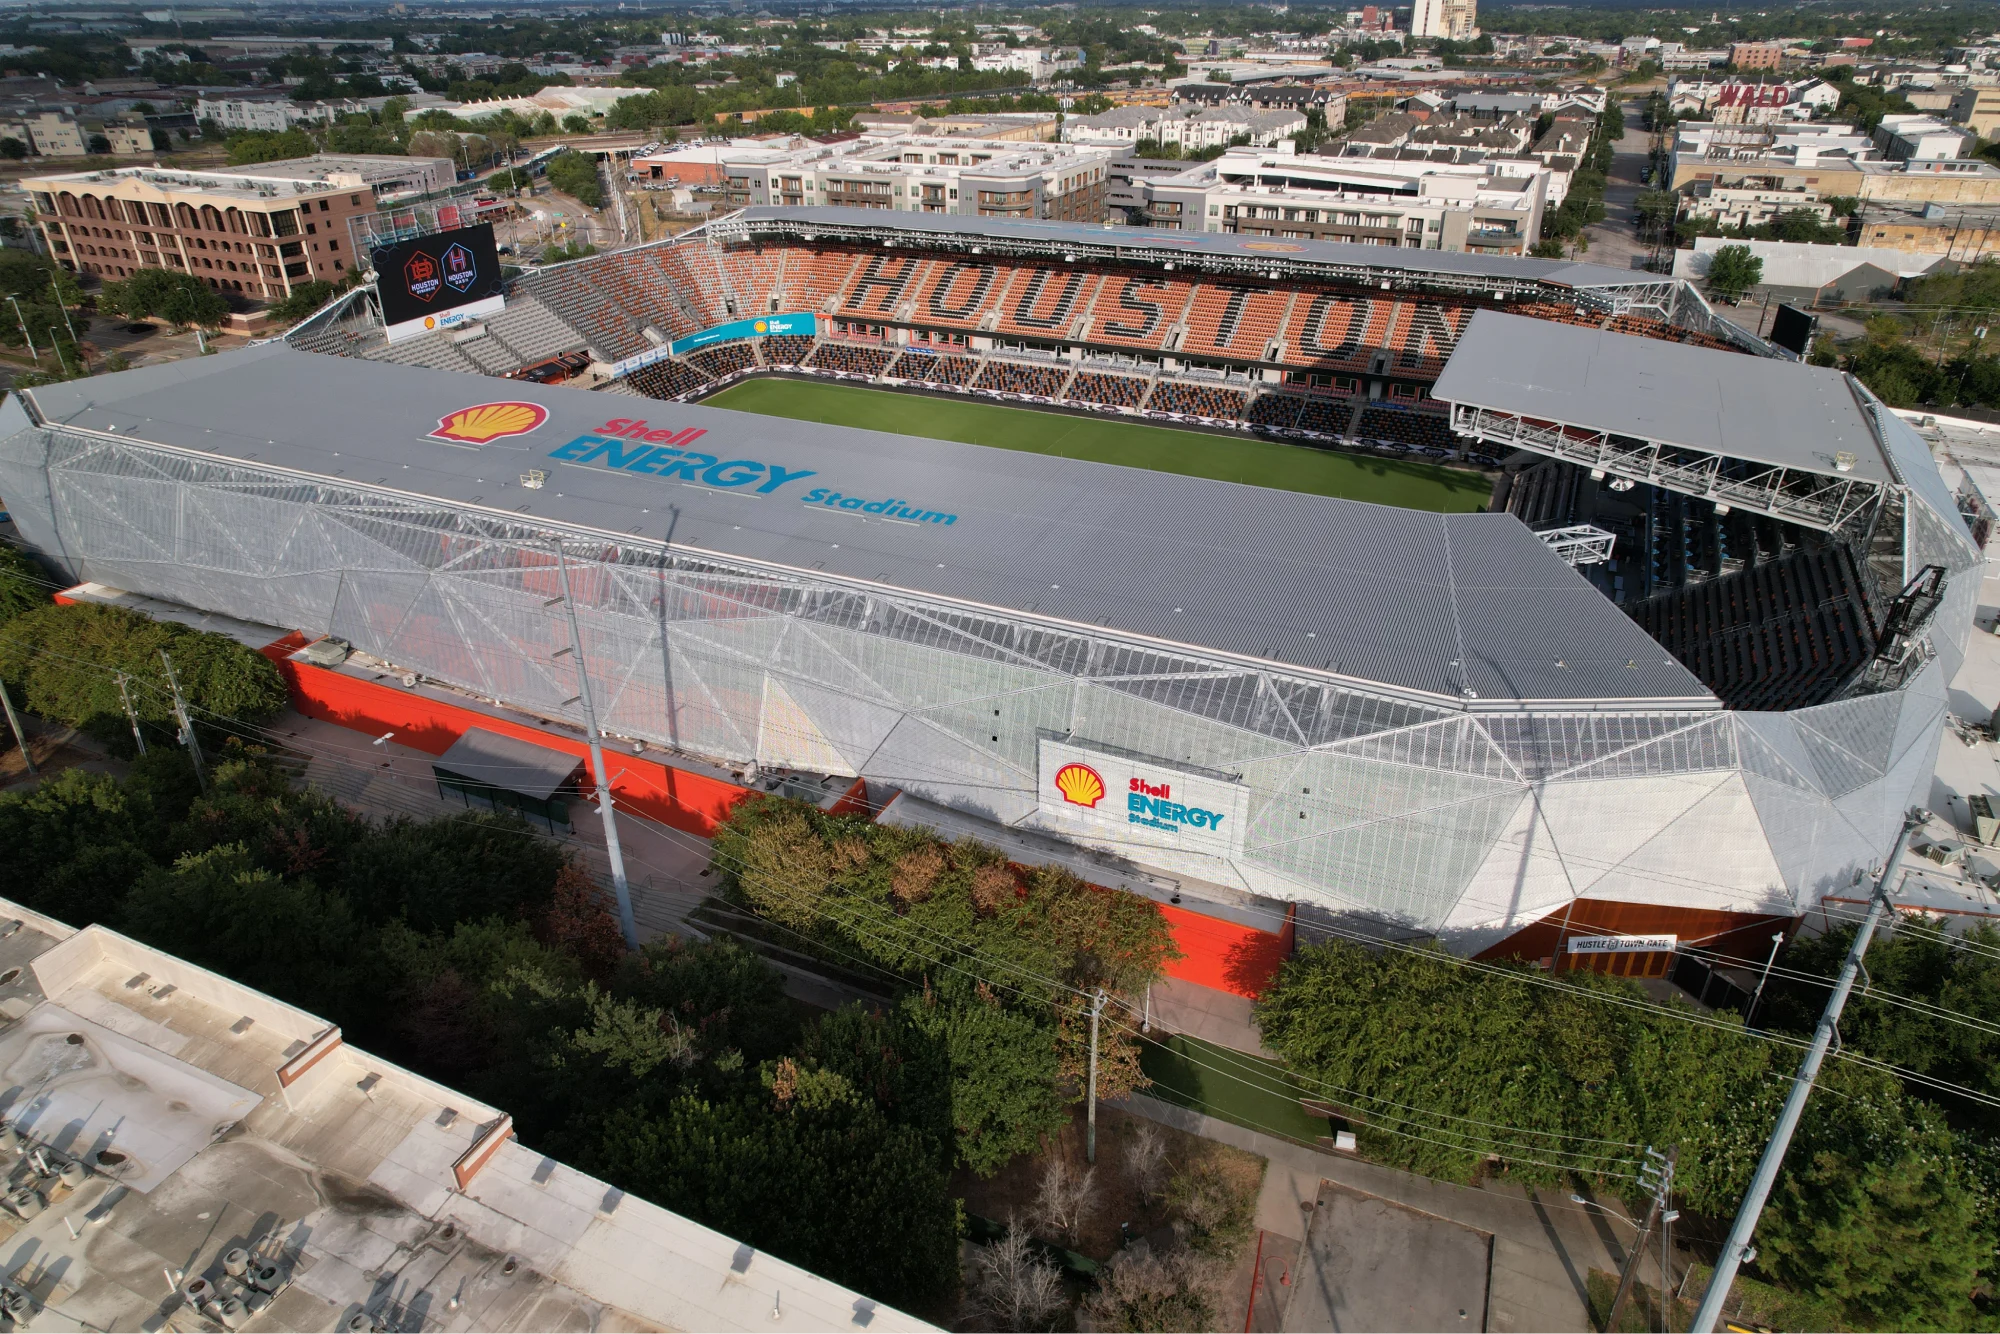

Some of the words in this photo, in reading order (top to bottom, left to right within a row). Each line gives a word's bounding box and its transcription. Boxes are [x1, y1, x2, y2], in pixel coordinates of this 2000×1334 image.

[1720, 84, 1789, 107] WALD
[411, 279, 439, 291] HOUSTON
[448, 270, 473, 281] HOUSTON
[440, 313, 464, 326] ENERGY
[846, 254, 1480, 368] HOUSTON
[593, 418, 708, 446] Shell
[547, 435, 818, 494] ENERGY
[801, 488, 958, 526] Stadium
[1129, 777, 1170, 799] Shell
[1128, 793, 1225, 831] ENERGY
[1128, 813, 1179, 833] Stadium
[1576, 940, 1606, 948] HUSTLE
